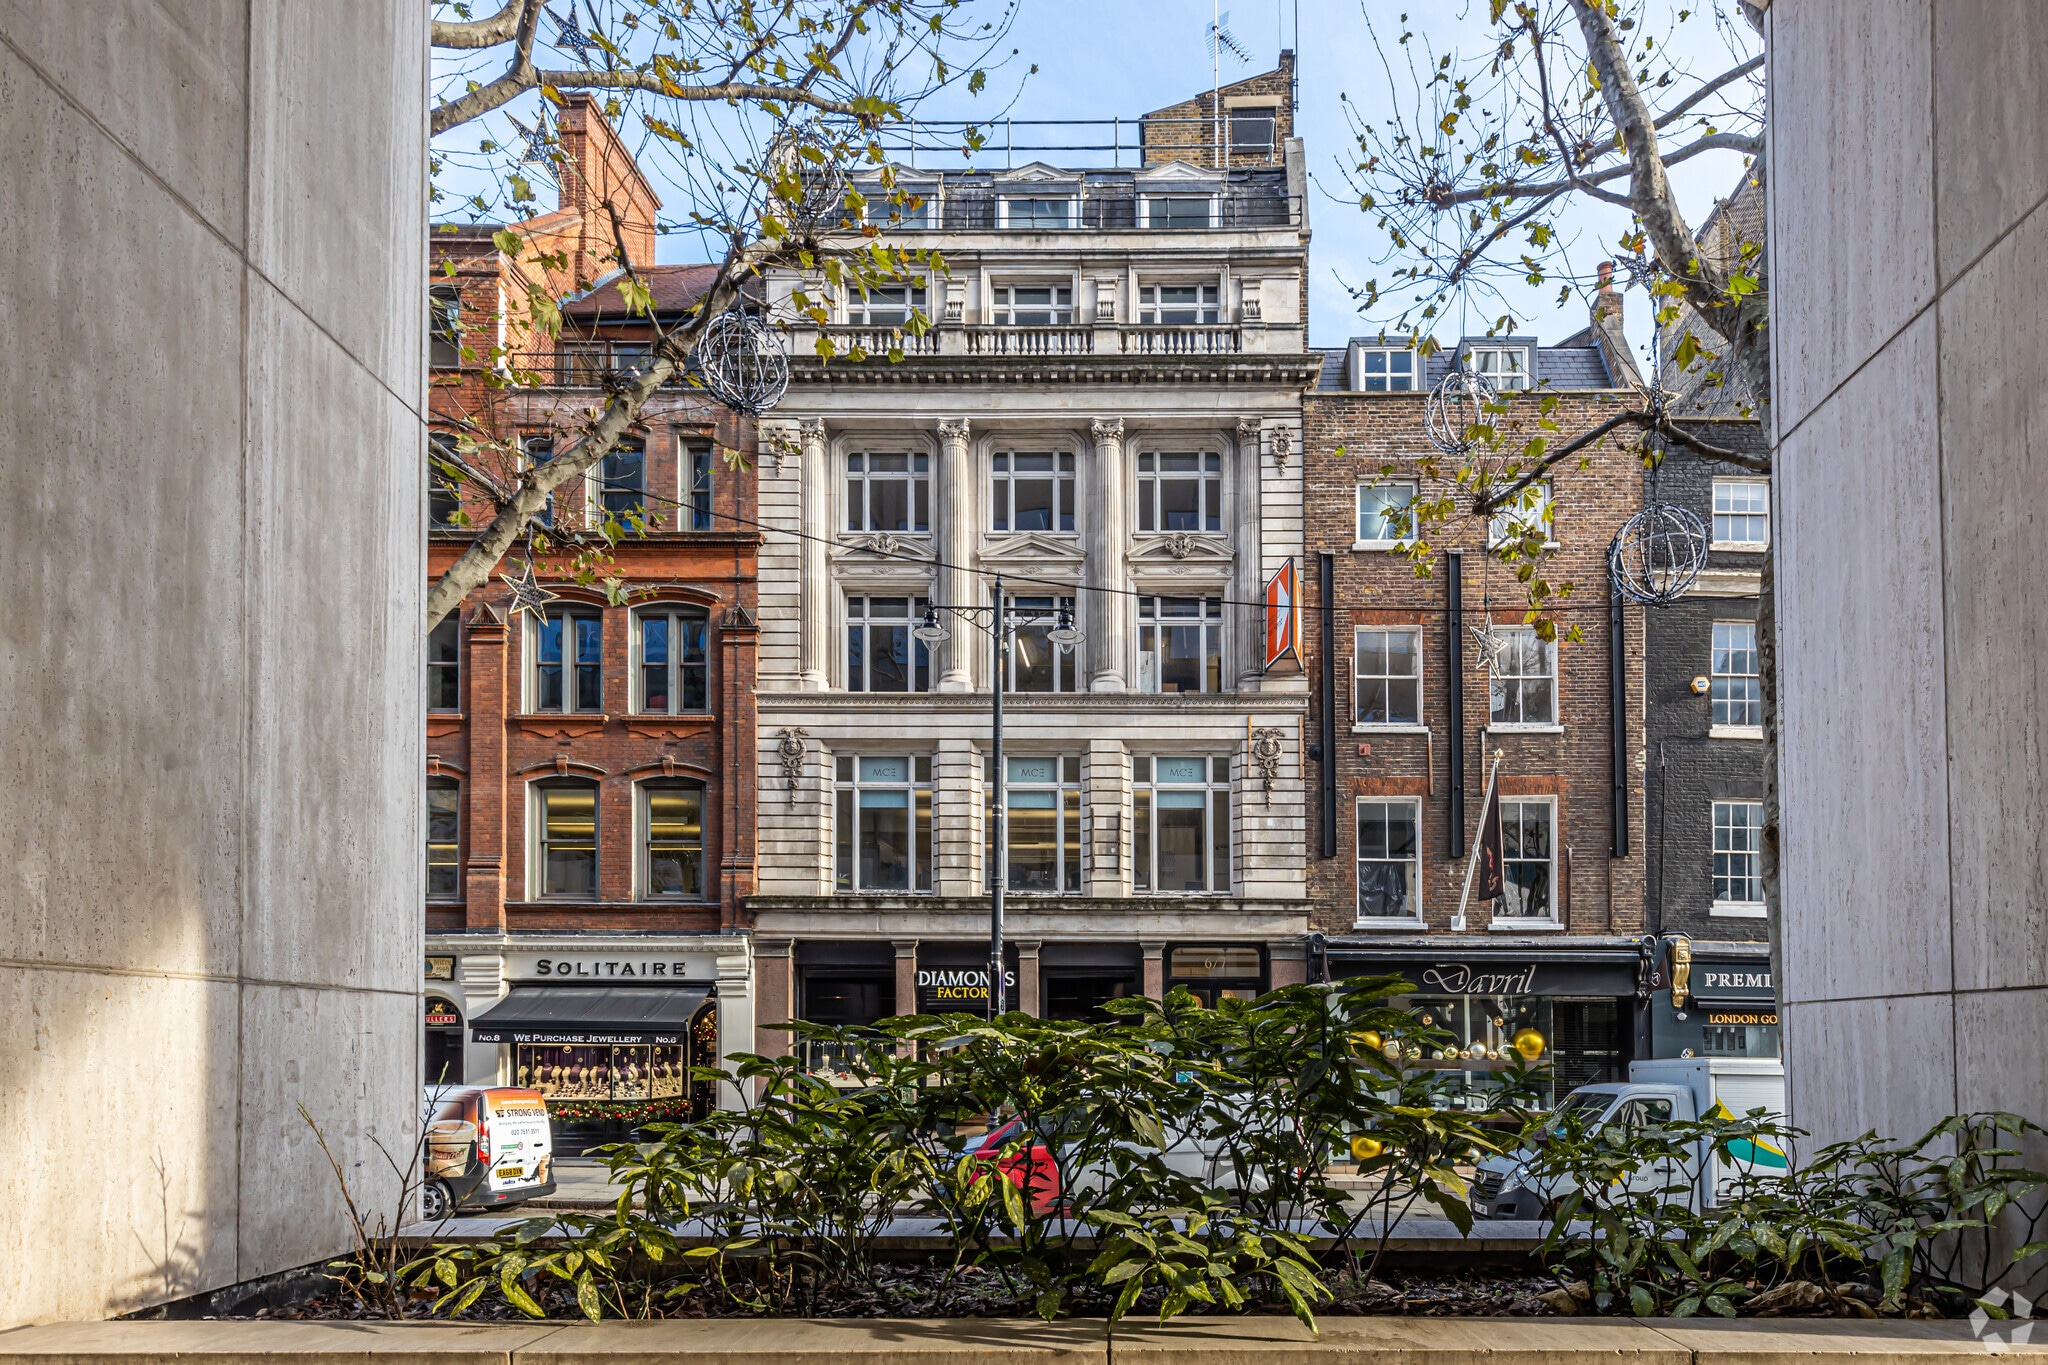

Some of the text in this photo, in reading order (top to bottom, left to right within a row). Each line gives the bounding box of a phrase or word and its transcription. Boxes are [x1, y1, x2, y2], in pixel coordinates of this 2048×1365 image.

[872, 767, 896, 777] MCE
[1020, 768, 1045, 778] MCE
[1169, 768, 1193, 777] MCE
[536, 959, 686, 977] SOLITAIRE
[918, 970, 1016, 987] DIAMONS
[1421, 963, 1537, 994] Davril
[1704, 972, 1775, 988] PREMI
[937, 986, 989, 999] FACTOR
[425, 1015, 454, 1023] ULLERS
[1709, 1014, 1779, 1025] LONDON GO
[478, 1034, 500, 1042] No.8
[513, 1034, 530, 1042] WE
[532, 1034, 584, 1043] PURCHASE
[586, 1035, 643, 1043] JEWELLERY
[506, 1108, 545, 1117] STRONG VEND
